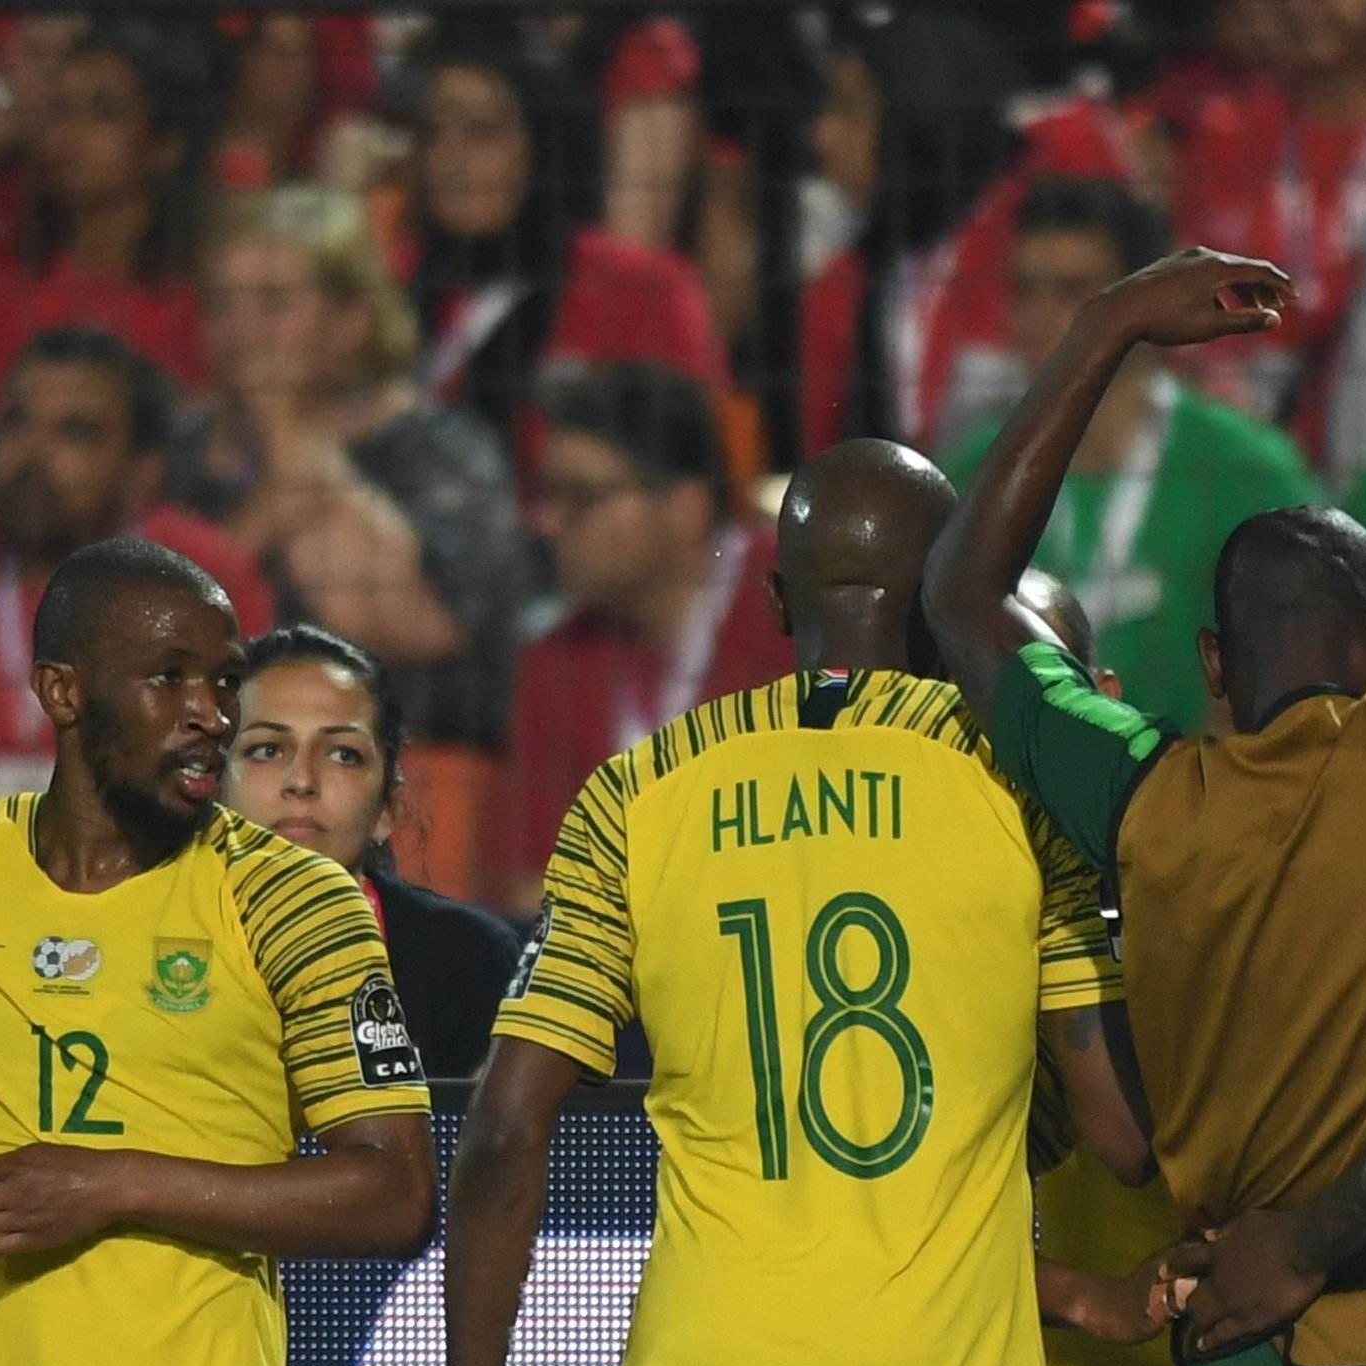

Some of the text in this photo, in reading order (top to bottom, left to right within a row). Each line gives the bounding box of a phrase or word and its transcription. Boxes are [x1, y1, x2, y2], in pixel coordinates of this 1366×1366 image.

[712, 767, 902, 853] HLANTI
[31, 1023, 125, 1136] 12
[716, 891, 934, 1181] 18
